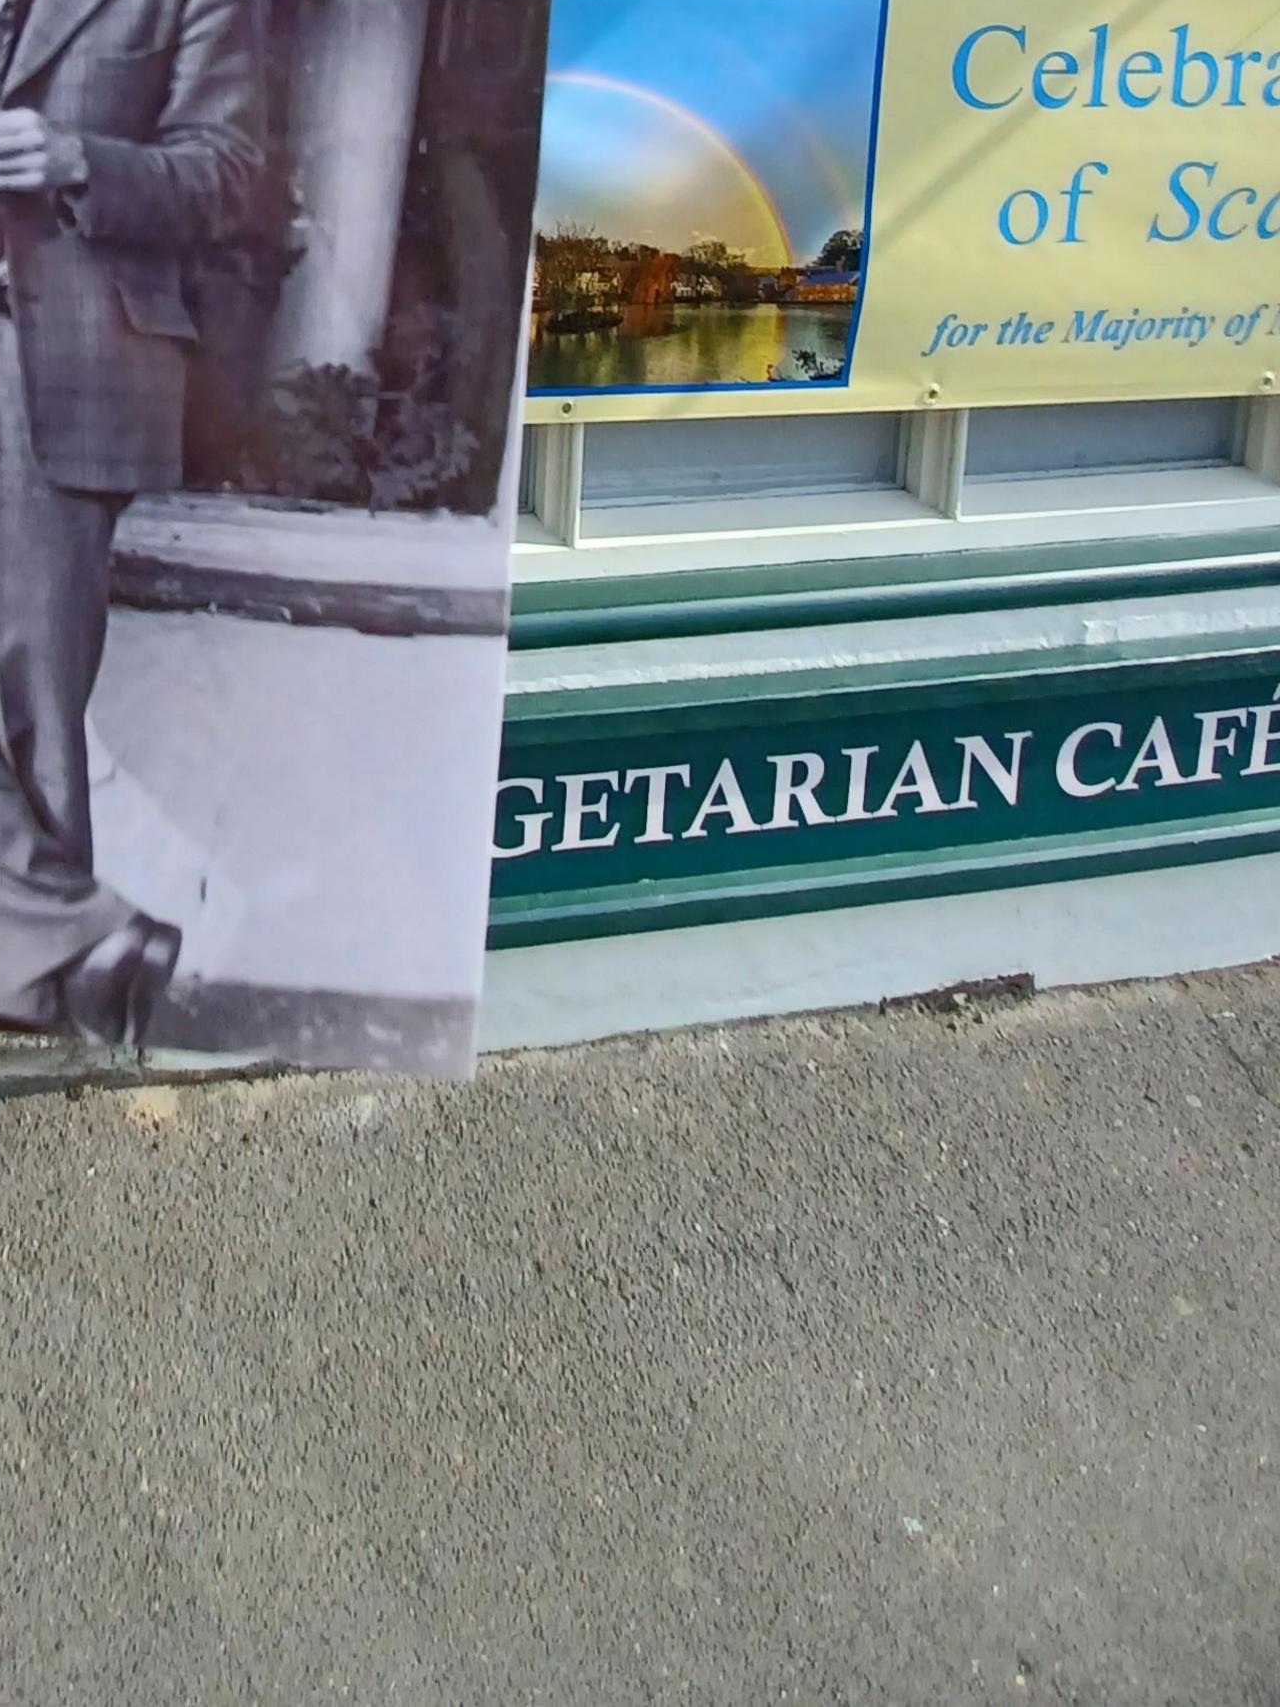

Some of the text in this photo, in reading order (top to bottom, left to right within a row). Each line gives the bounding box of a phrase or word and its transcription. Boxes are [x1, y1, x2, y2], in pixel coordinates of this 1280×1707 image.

[998, 161, 1109, 245] of
[921, 313, 988, 357] for
[996, 311, 1055, 346] the
[1061, 307, 1216, 351] Majority
[1224, 303, 1269, 346] of
[491, 683, 1280, 858] GETARIAN CAFÉ
